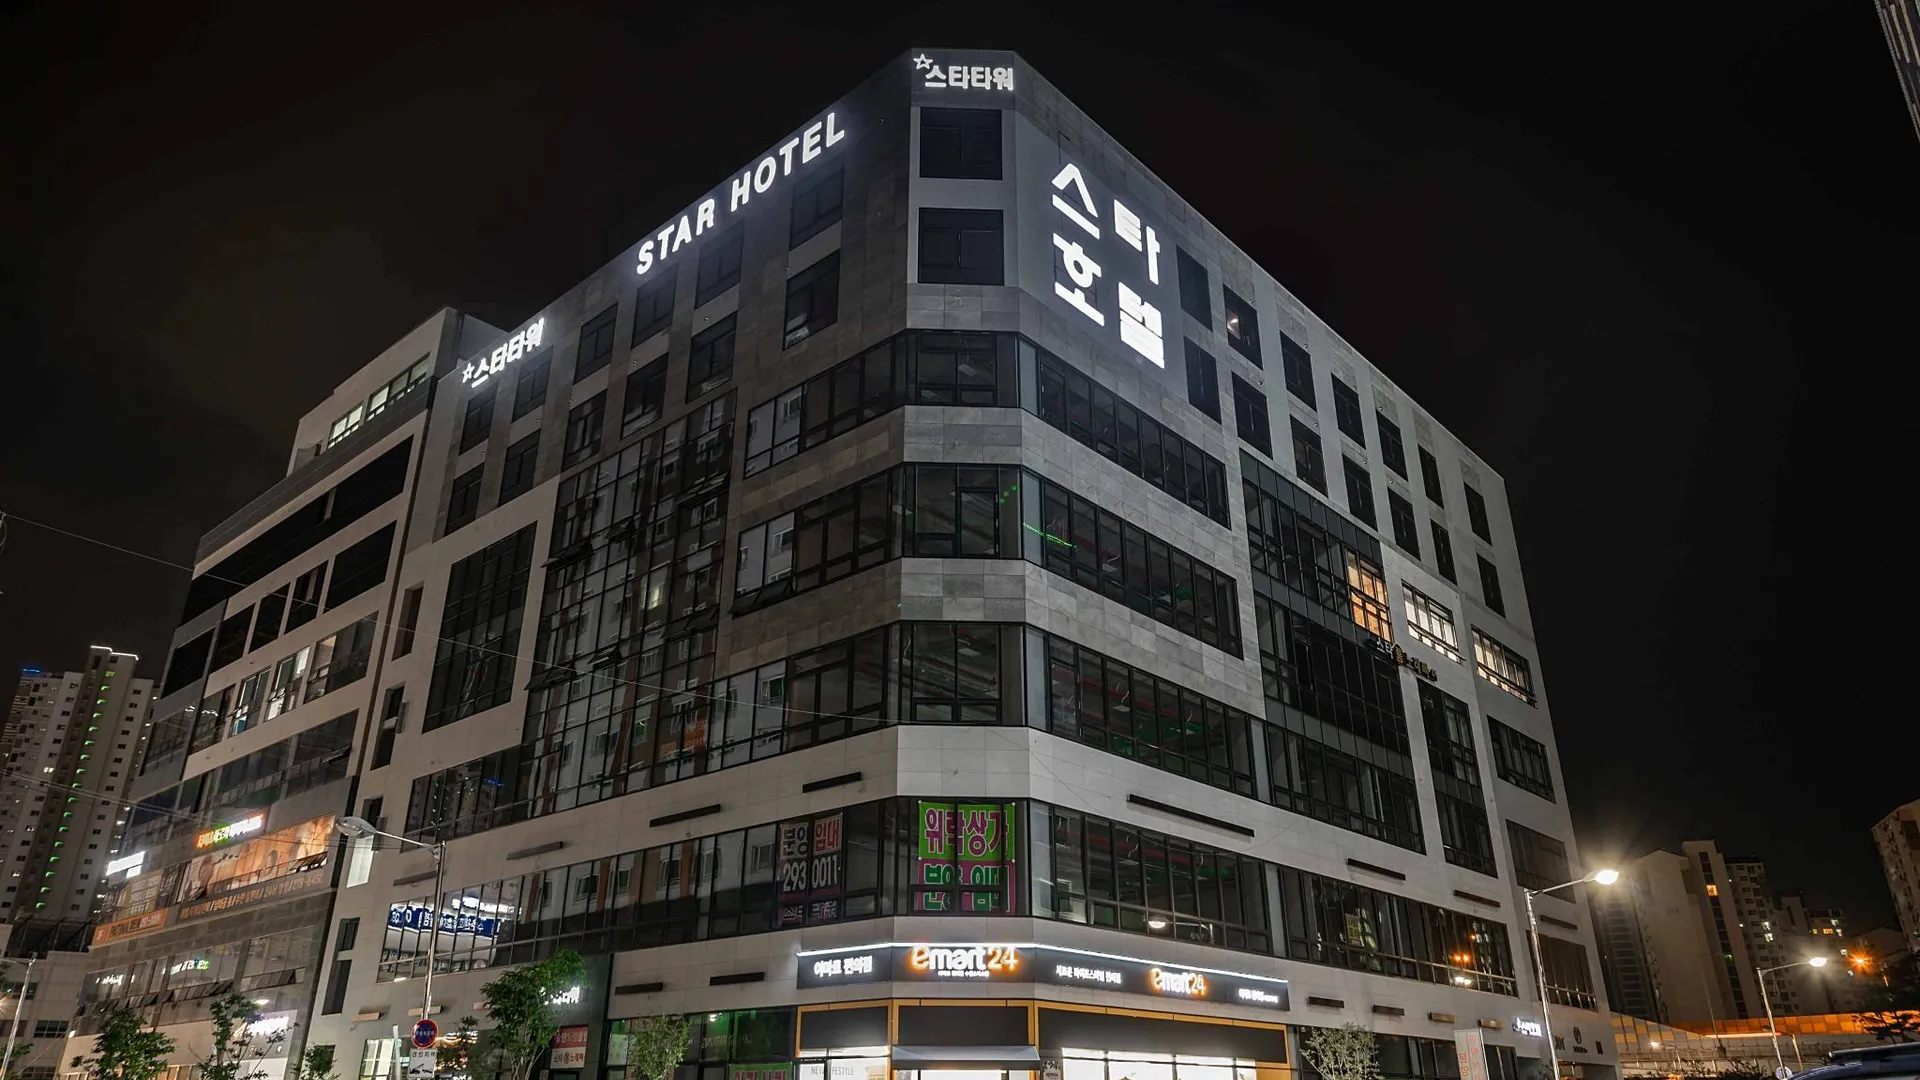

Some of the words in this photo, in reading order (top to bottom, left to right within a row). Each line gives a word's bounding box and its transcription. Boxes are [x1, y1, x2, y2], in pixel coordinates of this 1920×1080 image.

[925, 65, 1014, 91] 스타타워
[636, 198, 715, 275] STAR
[730, 112, 845, 212] HOTEL
[1052, 163, 1161, 285] 스타
[1053, 233, 1165, 369] 호텔
[471, 317, 545, 388] 스타타워
[816, 818, 840, 852] 임대
[925, 808, 1010, 857] 위락상가
[783, 861, 806, 892] 293
[812, 855, 838, 889] 0011
[814, 960, 842, 977] 이마트
